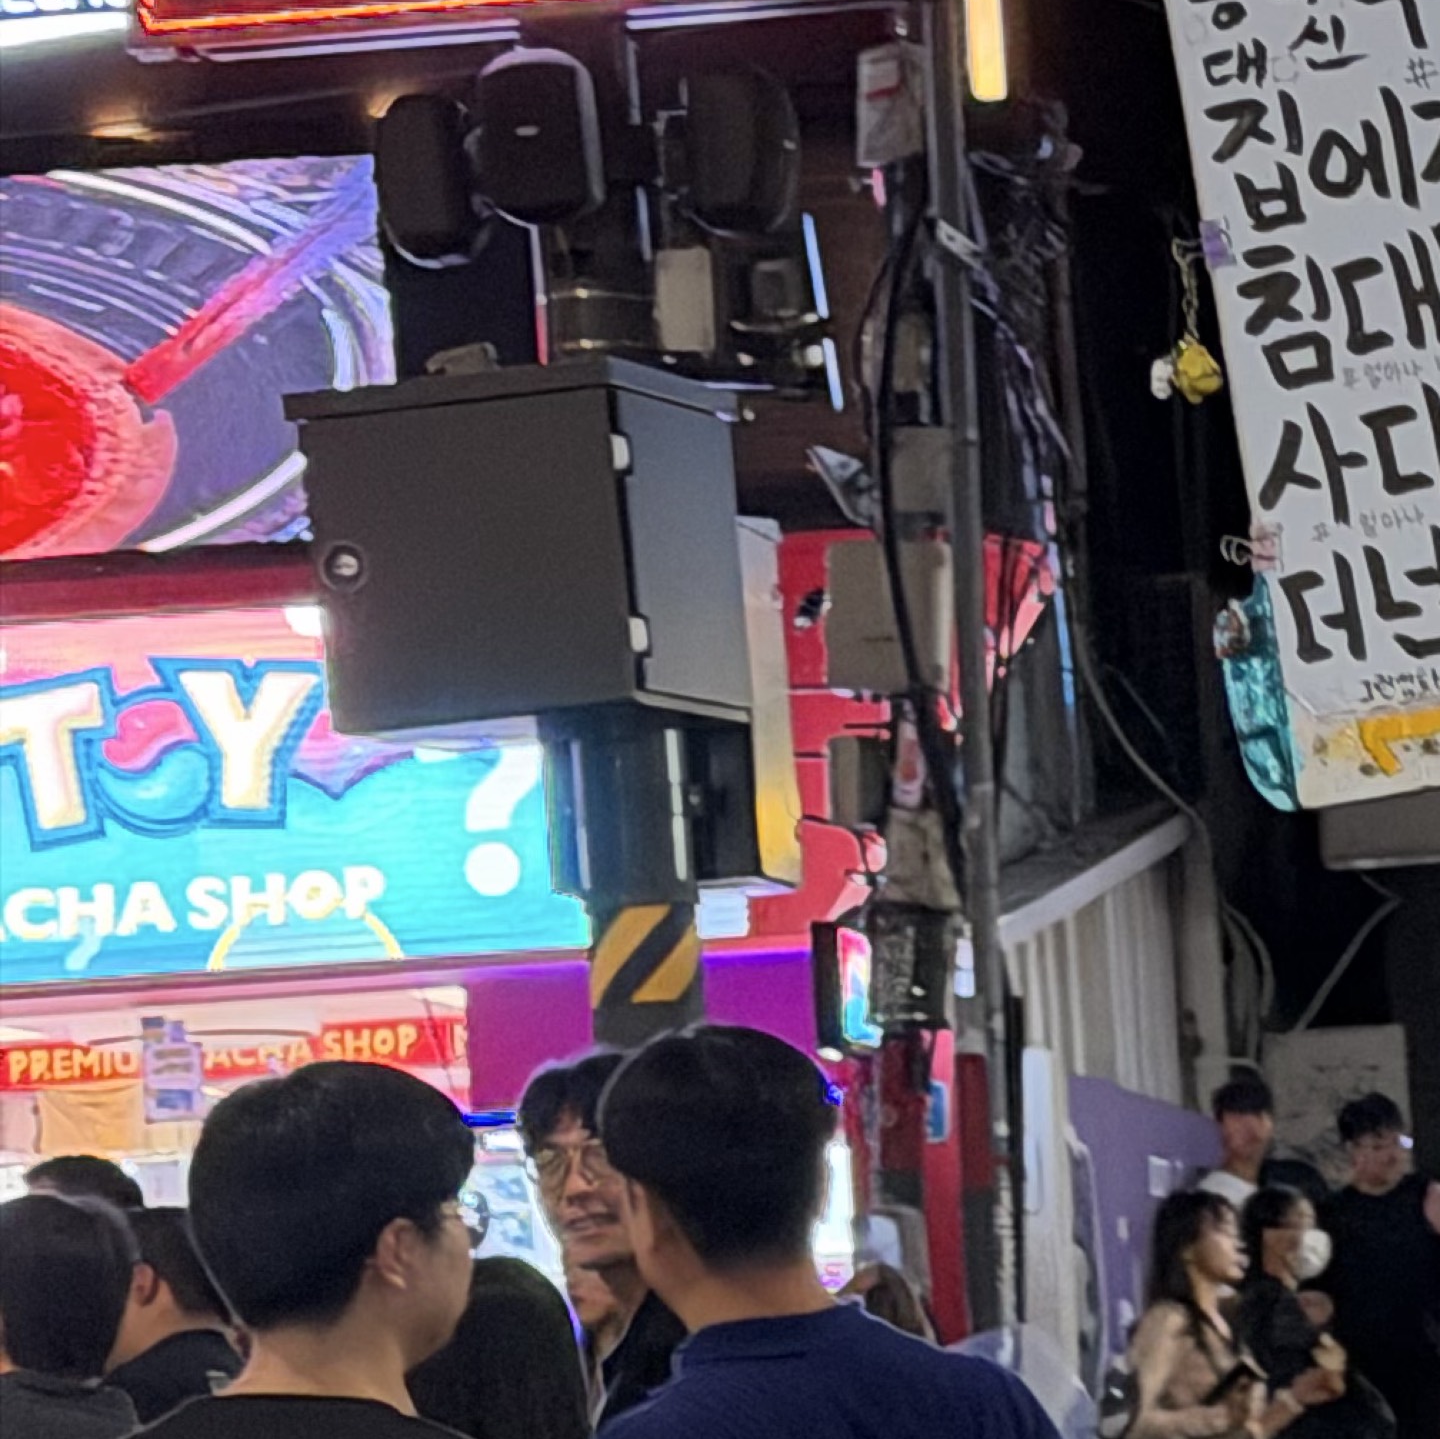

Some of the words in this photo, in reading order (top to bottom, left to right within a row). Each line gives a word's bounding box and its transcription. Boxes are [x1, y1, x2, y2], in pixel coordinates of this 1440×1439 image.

[0, 880, 178, 942] CHA
[185, 865, 387, 931] SHOP
[8, 1048, 140, 1083] PREMIU
[322, 1025, 419, 1061] SHOP
